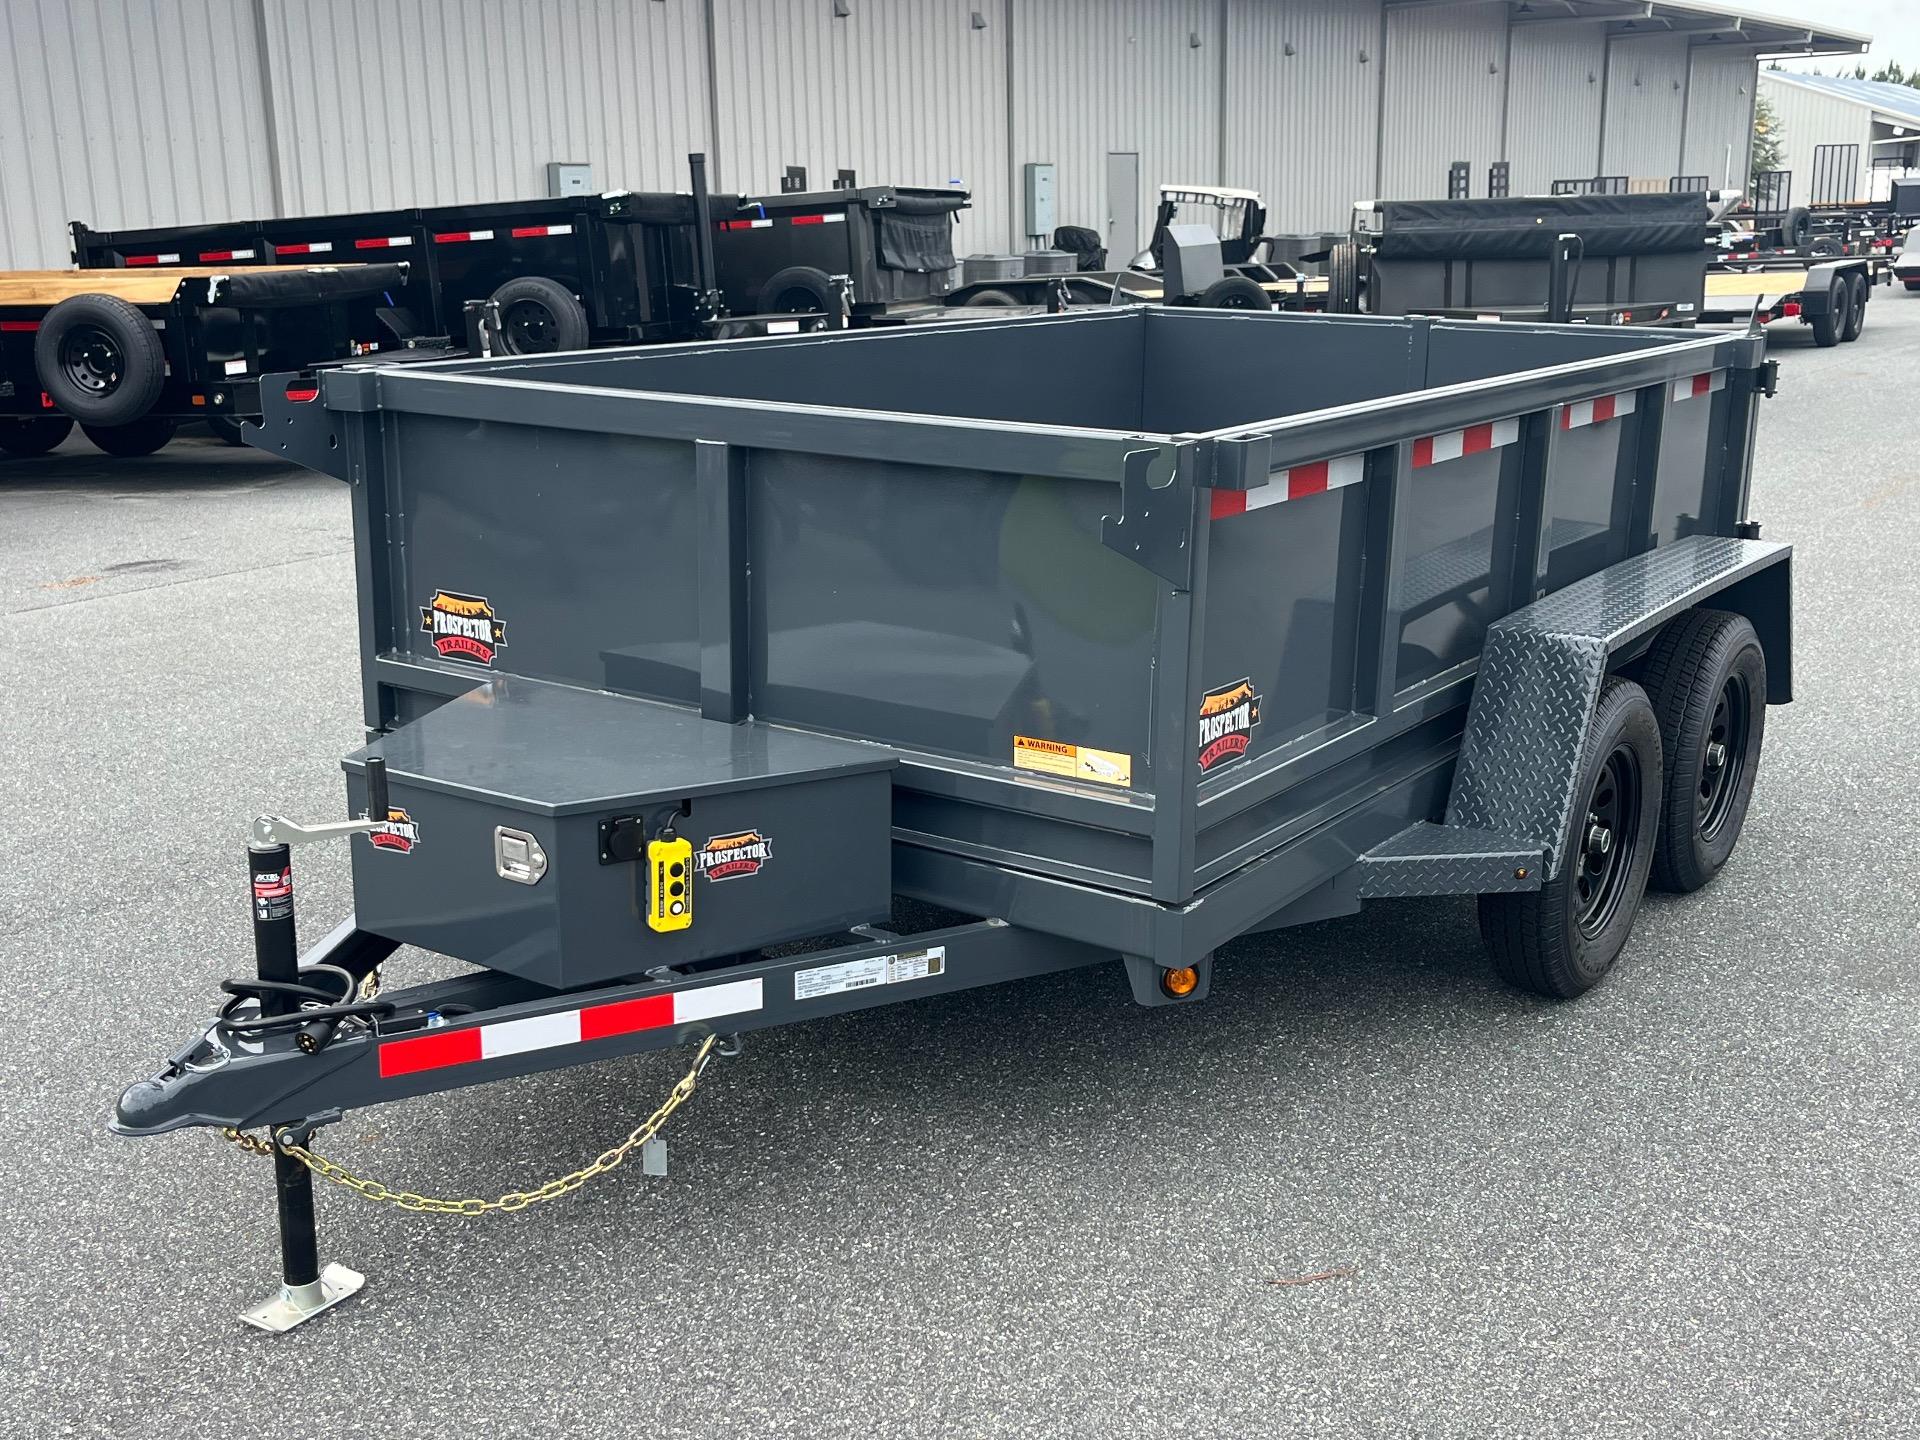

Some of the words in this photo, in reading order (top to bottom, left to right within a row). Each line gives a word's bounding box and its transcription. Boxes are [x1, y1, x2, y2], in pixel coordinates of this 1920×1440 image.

[433, 610, 494, 643] PROSPECTOR
[440, 641, 489, 659] TRAILERS
[1199, 702, 1250, 747] PROSPECTOR
[1027, 740, 1068, 754] WARNING
[1203, 738, 1245, 763] TRAILERS
[364, 817, 416, 840] PECTOR
[700, 842, 767, 869] PROSPECTOR
[712, 862, 755, 875] TRAILERS
